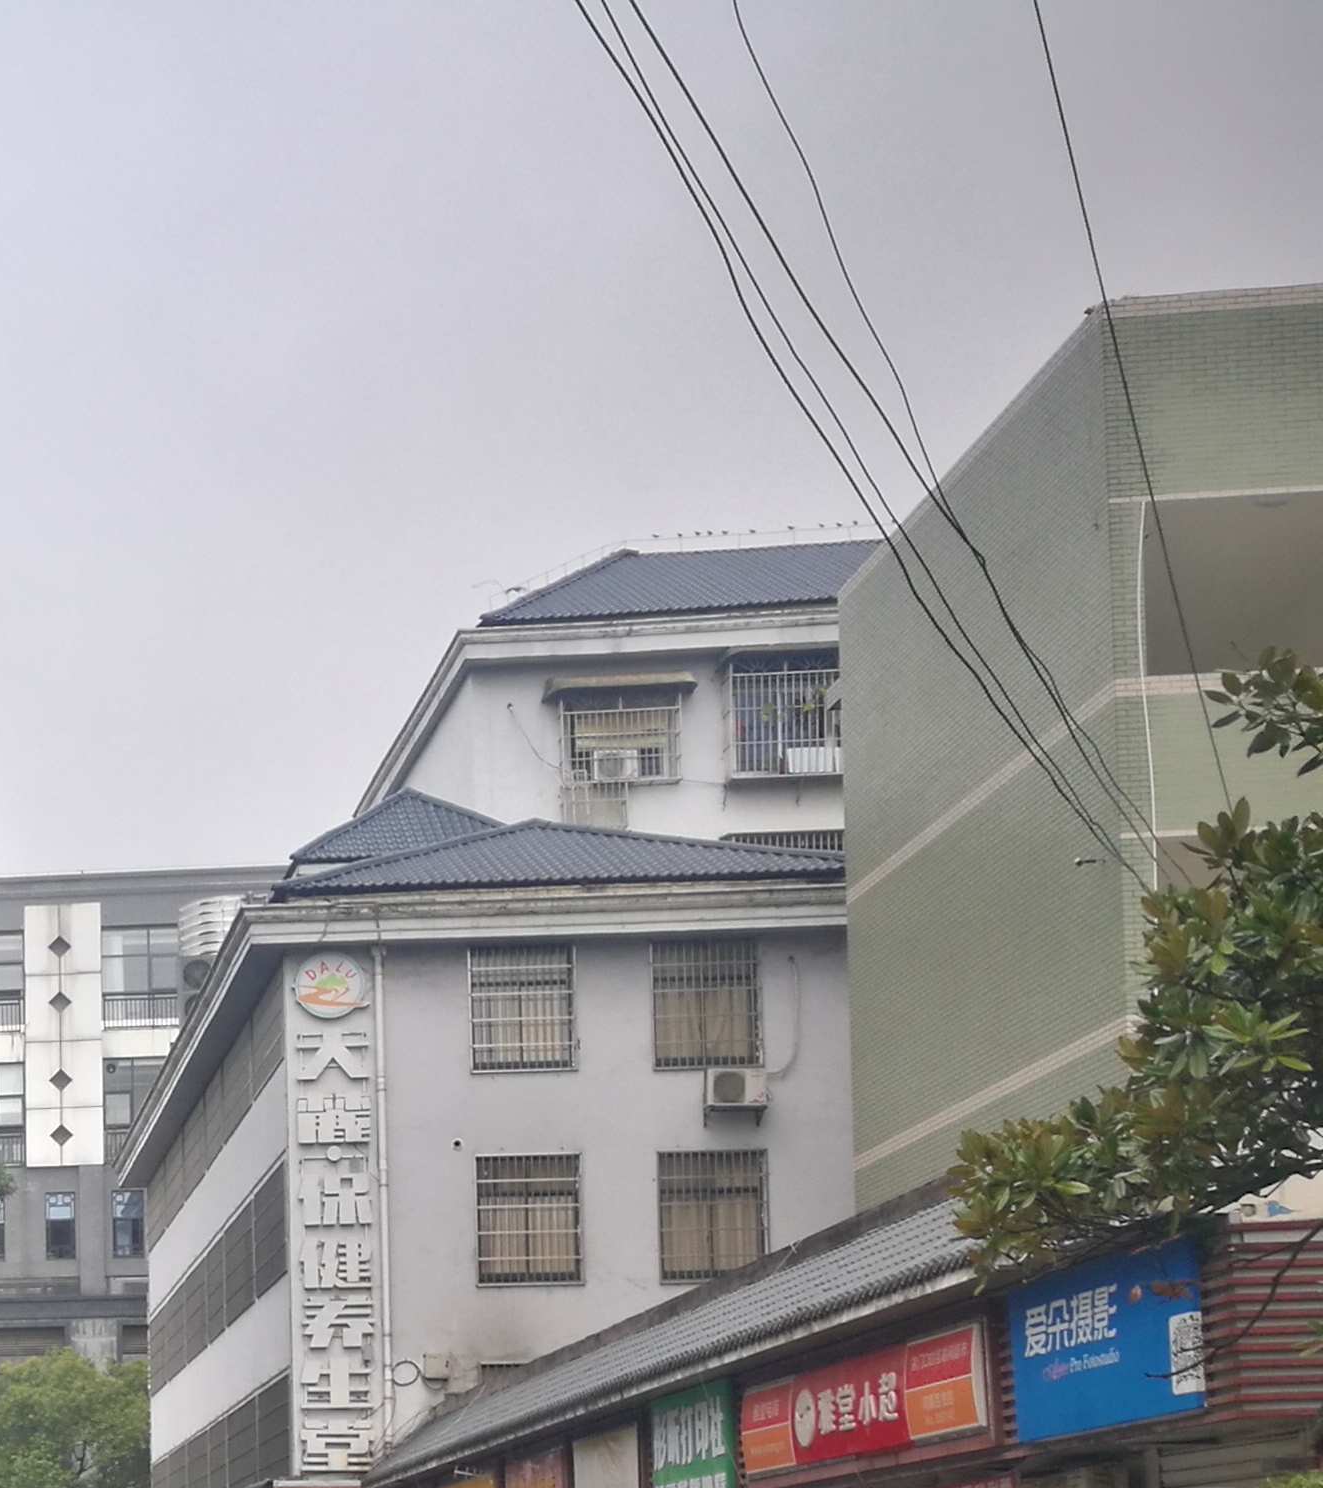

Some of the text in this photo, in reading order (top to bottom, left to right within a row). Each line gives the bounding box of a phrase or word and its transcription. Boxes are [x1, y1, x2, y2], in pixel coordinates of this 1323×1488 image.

[305, 960, 357, 982] DALU
[1023, 1283, 1118, 1358] 爱朵摄影
